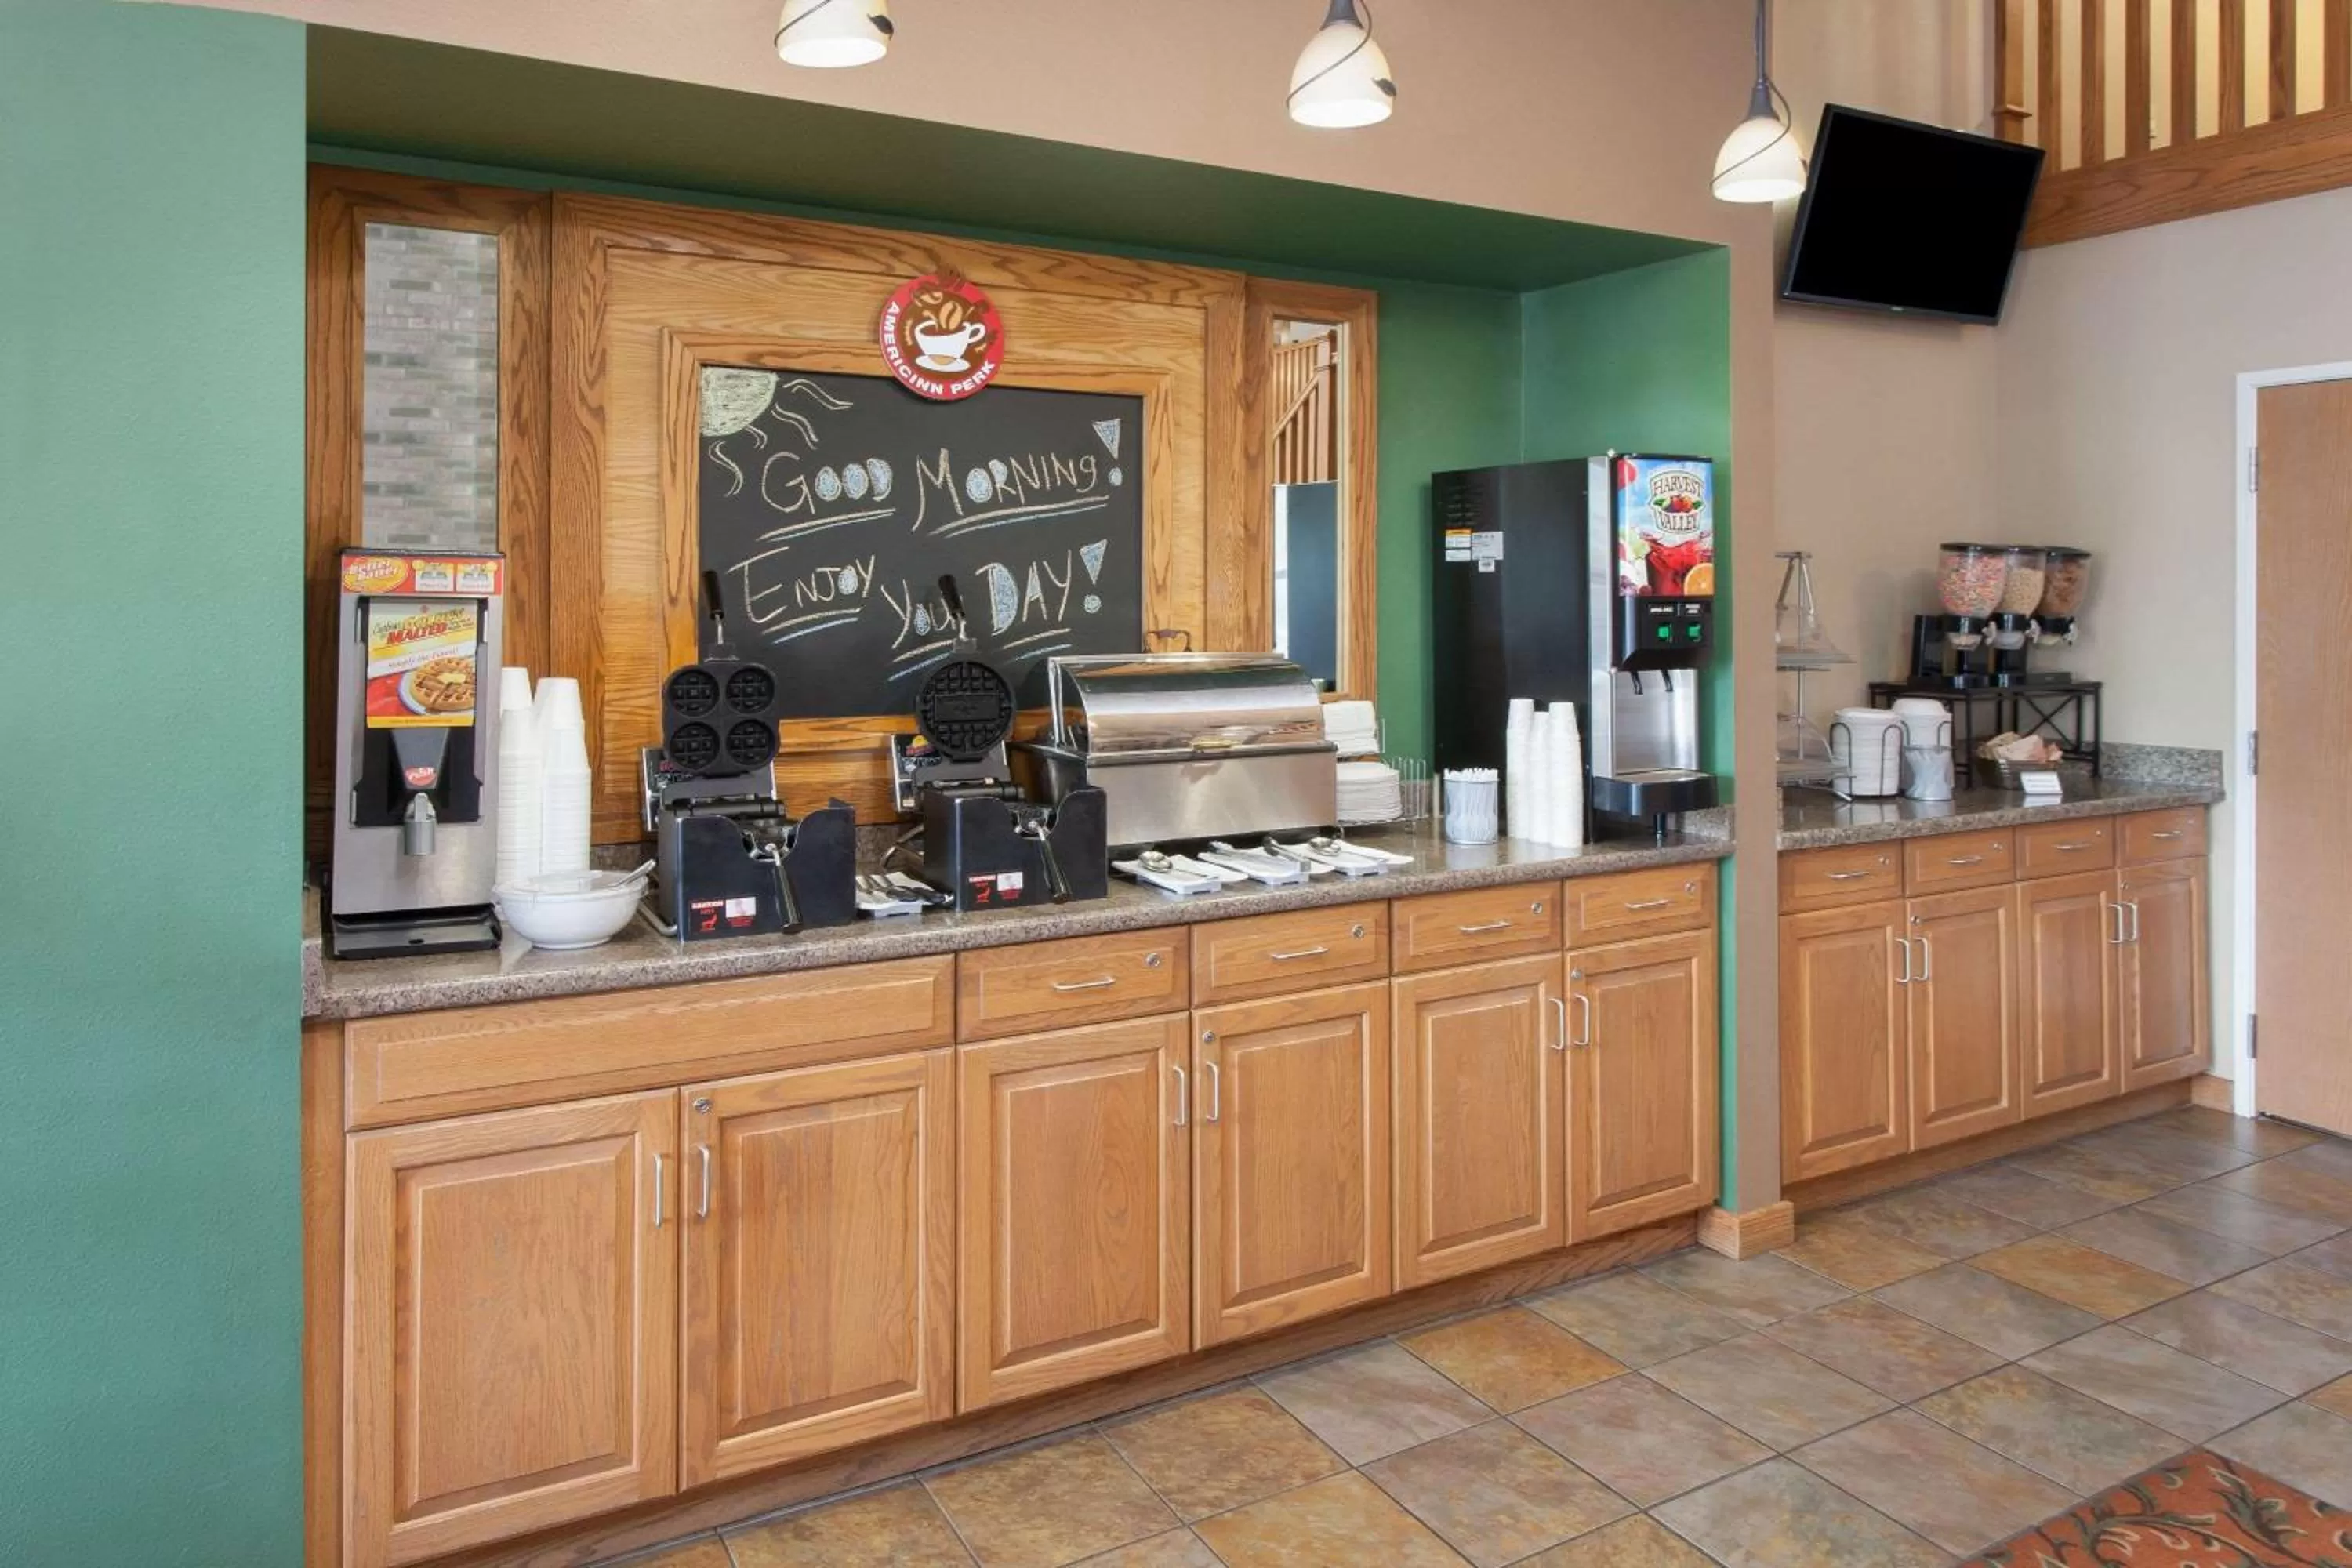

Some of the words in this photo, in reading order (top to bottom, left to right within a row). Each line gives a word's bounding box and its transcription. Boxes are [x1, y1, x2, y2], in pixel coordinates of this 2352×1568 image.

[883, 300, 943, 394] AMERICINN
[949, 359, 995, 394] PERK
[760, 450, 894, 515] GOOD
[1653, 475, 1701, 498] HARVEST
[1657, 510, 1700, 532] VALLEY
[726, 546, 876, 623] ENJOY
